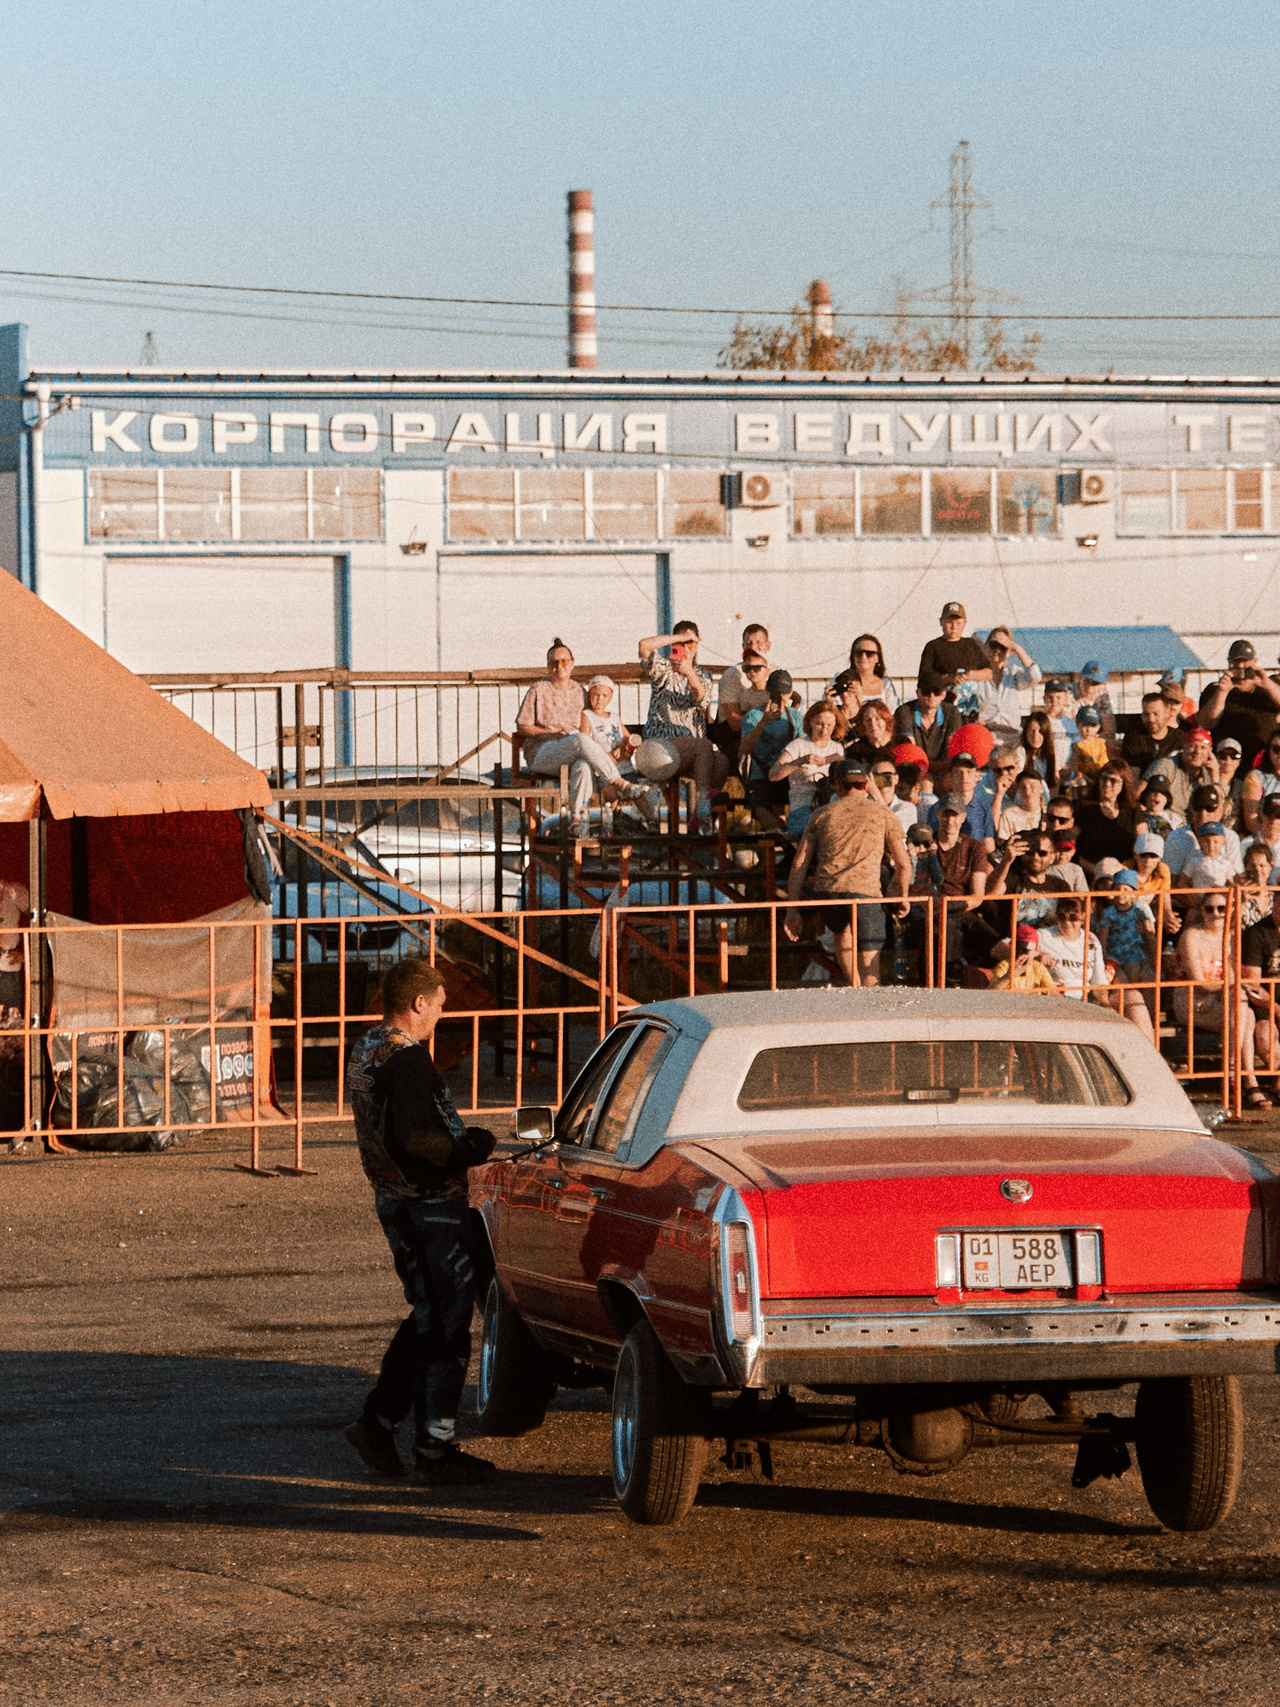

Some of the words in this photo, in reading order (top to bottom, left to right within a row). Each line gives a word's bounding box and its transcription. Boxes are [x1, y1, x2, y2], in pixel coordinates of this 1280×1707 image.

[90, 409, 668, 459] КОРПОРАЦИЯ
[734, 411, 1113, 458] ВЕДУЩИХ
[970, 1239, 993, 1255] 01
[1012, 1238, 1057, 1260] 588
[975, 1272, 989, 1283] KG
[1017, 1264, 1056, 1283] AEP
